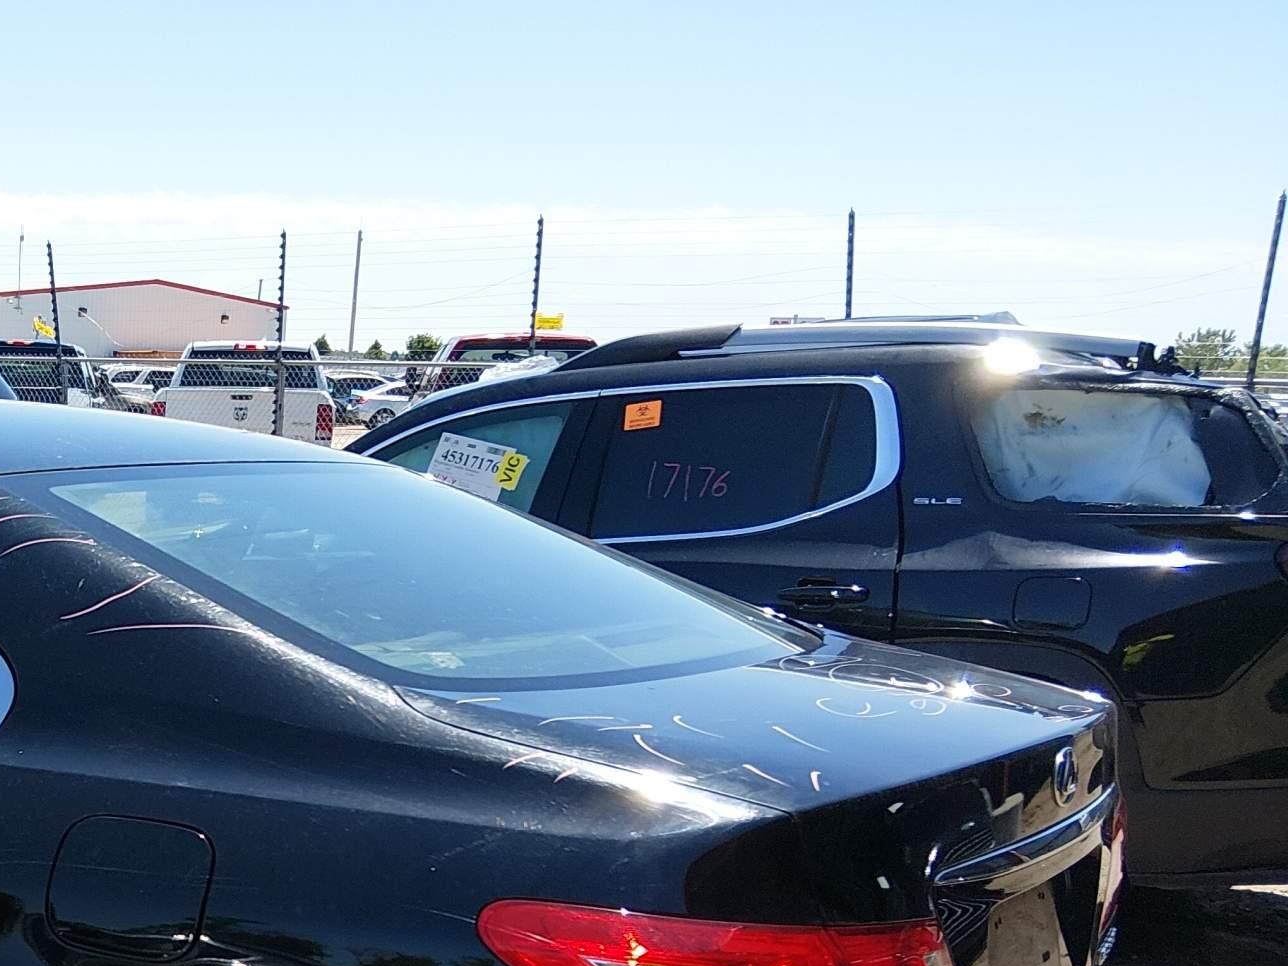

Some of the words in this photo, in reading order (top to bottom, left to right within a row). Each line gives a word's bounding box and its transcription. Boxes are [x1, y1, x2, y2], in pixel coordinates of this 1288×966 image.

[441, 449, 500, 474] 45317176
[499, 456, 520, 484] VIC
[648, 461, 731, 502] 17176
[913, 497, 962, 505] SLE
